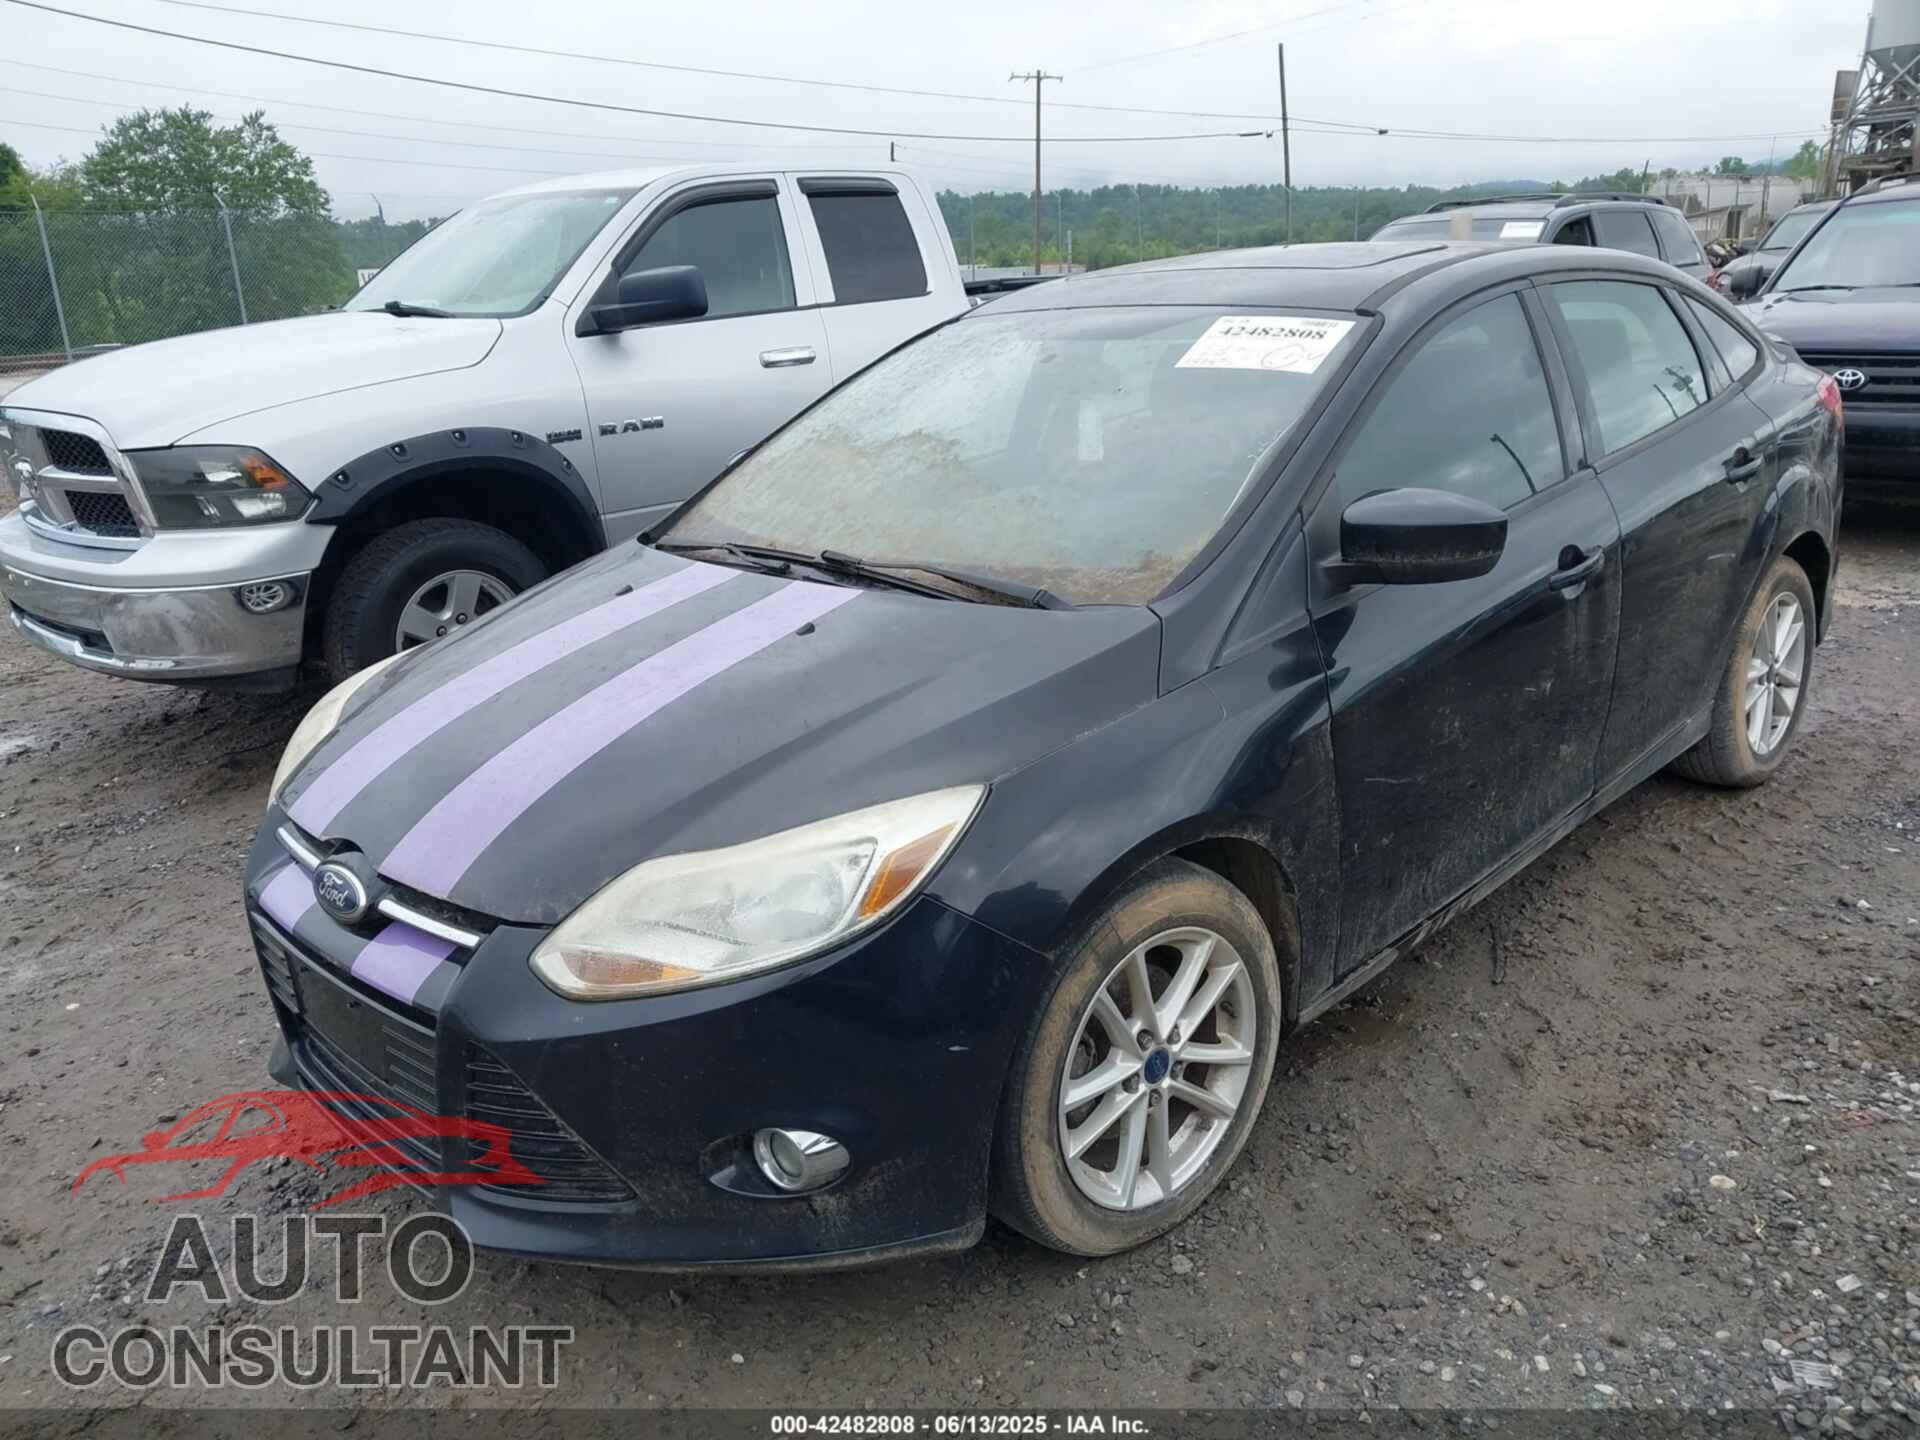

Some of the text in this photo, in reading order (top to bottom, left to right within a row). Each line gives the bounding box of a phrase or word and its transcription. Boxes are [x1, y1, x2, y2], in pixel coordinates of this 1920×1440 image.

[1218, 325, 1328, 341] 42482808
[599, 416, 664, 436] RAM
[318, 871, 349, 907] Ford
